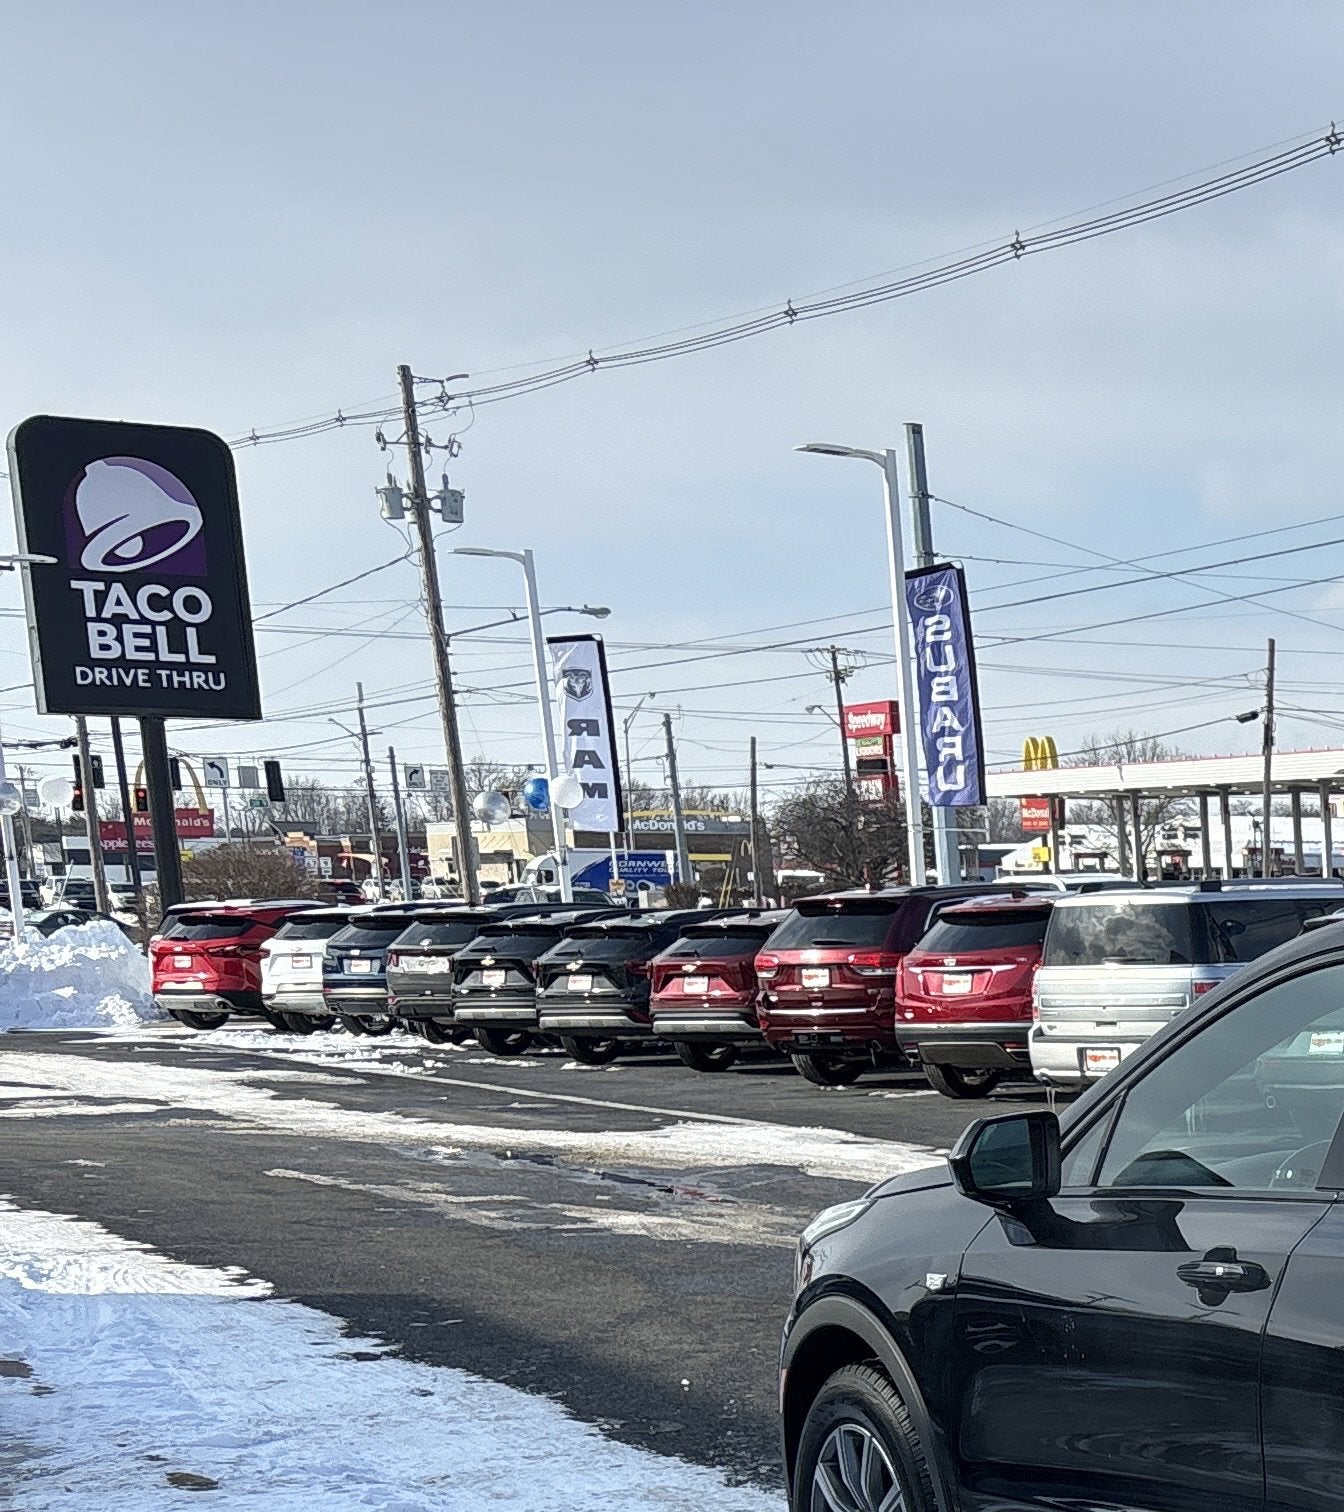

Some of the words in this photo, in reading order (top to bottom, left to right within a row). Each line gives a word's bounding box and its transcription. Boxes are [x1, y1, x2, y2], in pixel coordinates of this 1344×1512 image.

[70, 580, 213, 624] TACO
[86, 621, 217, 664] BELL
[75, 666, 151, 687] DRIVE
[156, 669, 226, 690] THRU
[134, 817, 210, 827] Mcnald's
[628, 819, 705, 831] McDonld's
